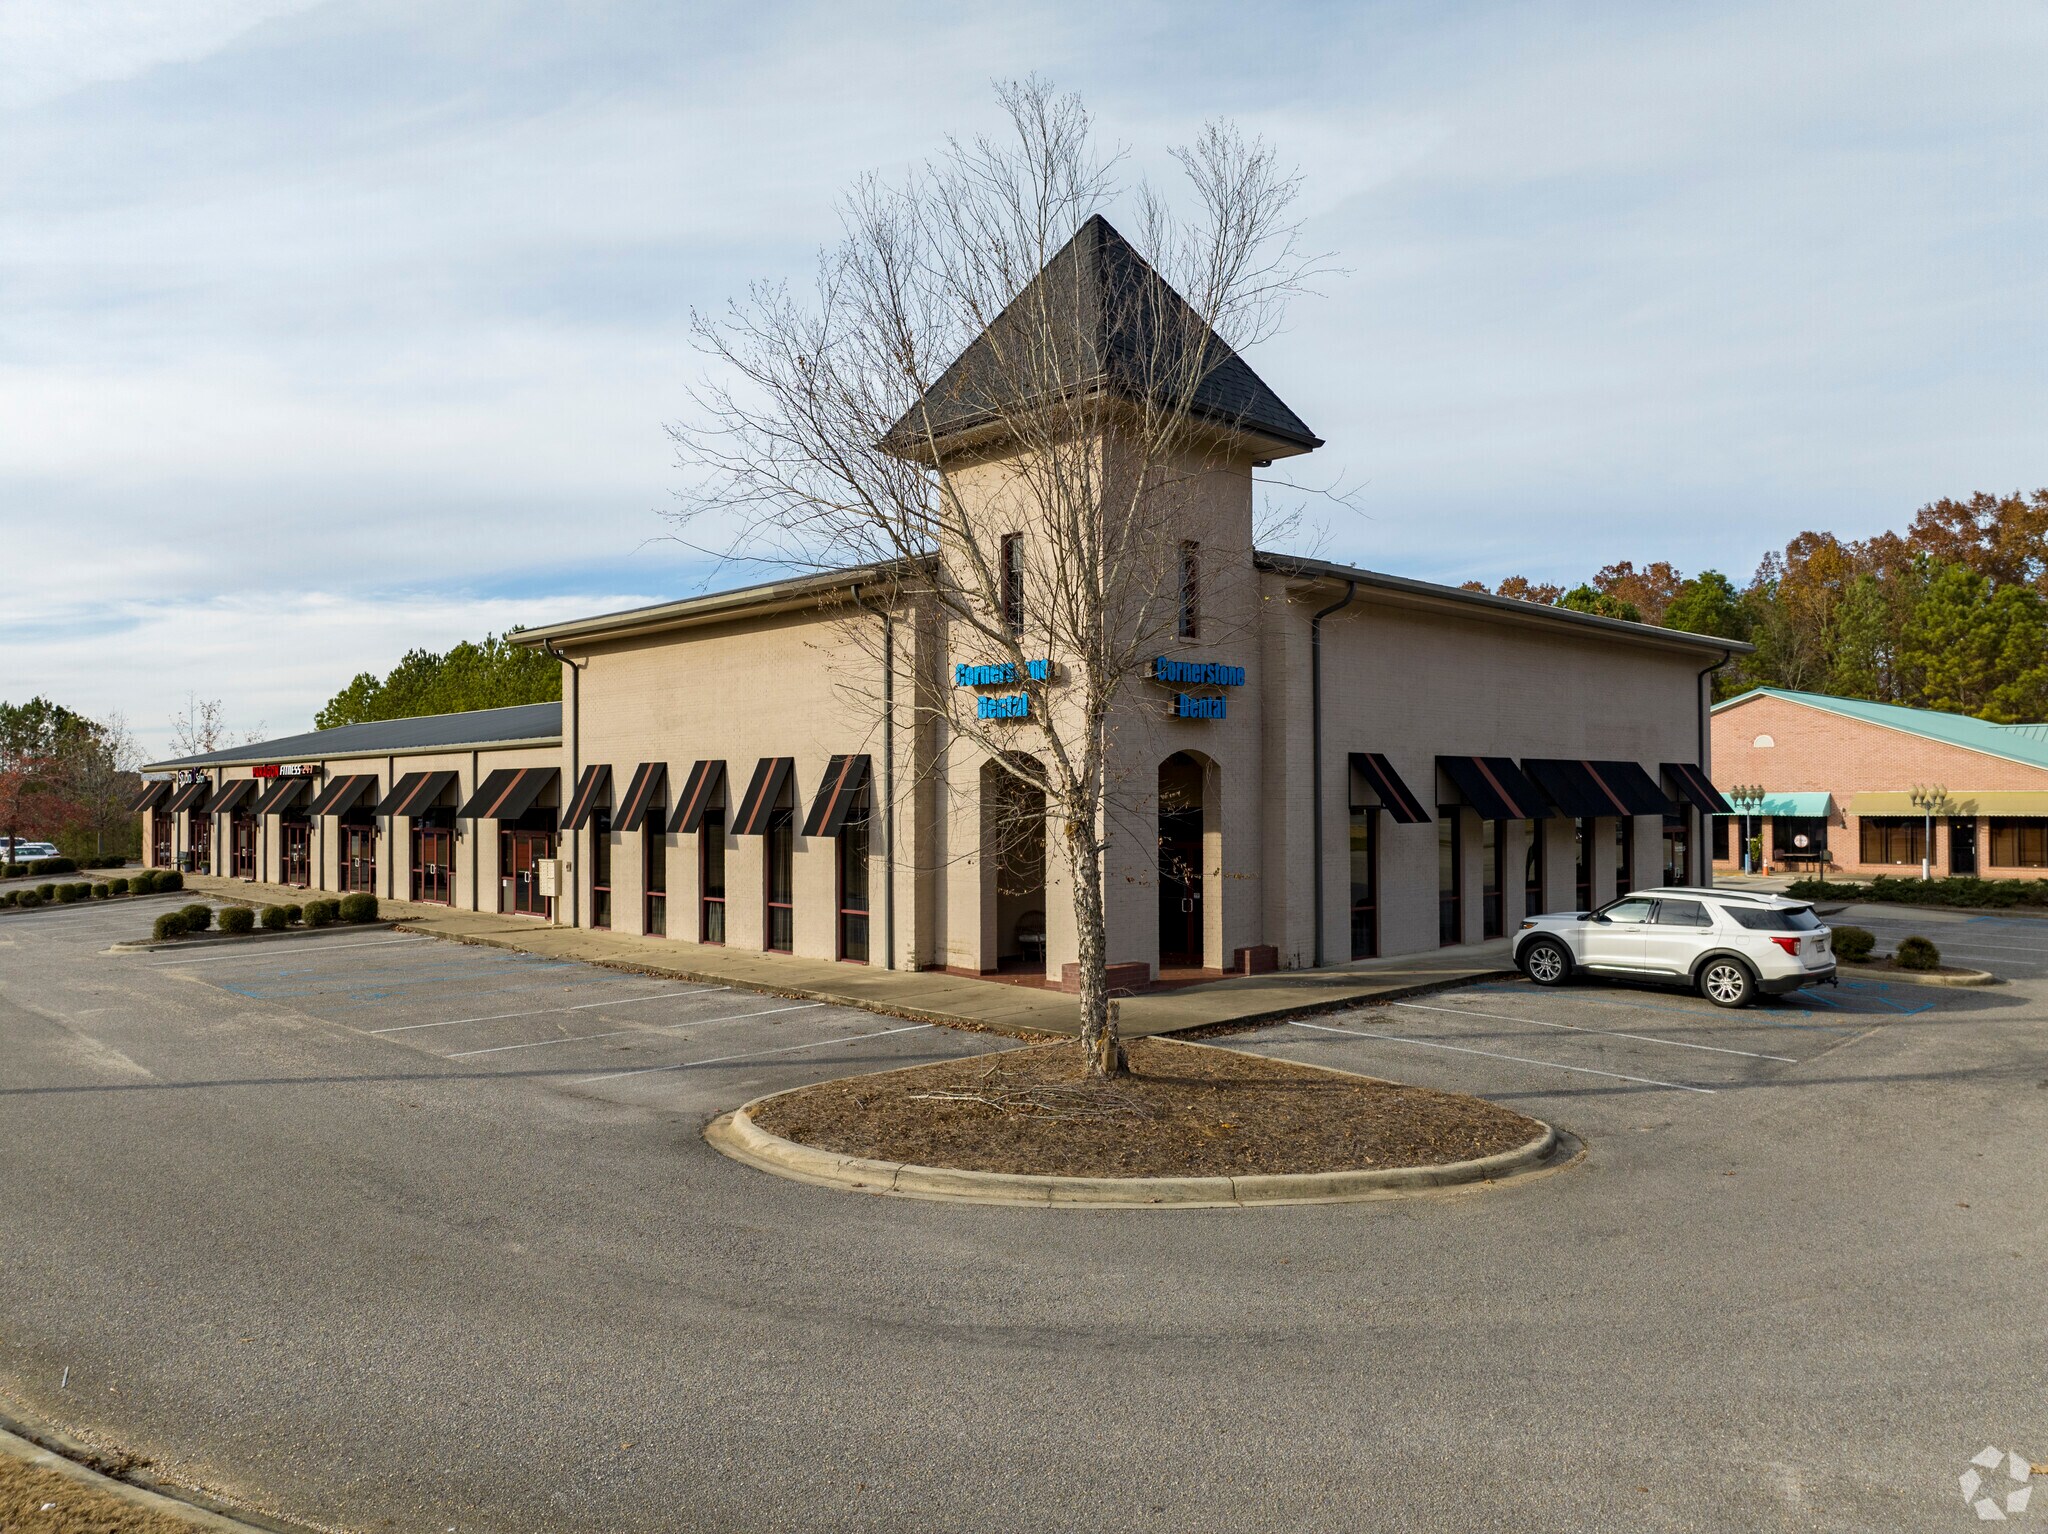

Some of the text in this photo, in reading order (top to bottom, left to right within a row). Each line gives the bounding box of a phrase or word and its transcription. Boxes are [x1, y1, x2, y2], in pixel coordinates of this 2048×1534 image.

[956, 658, 1051, 687] Cornersne
[1157, 655, 1245, 687] Cornerstone
[977, 691, 1028, 720] Dental
[1180, 692, 1227, 719] Dental
[280, 765, 301, 776] FITNESS
